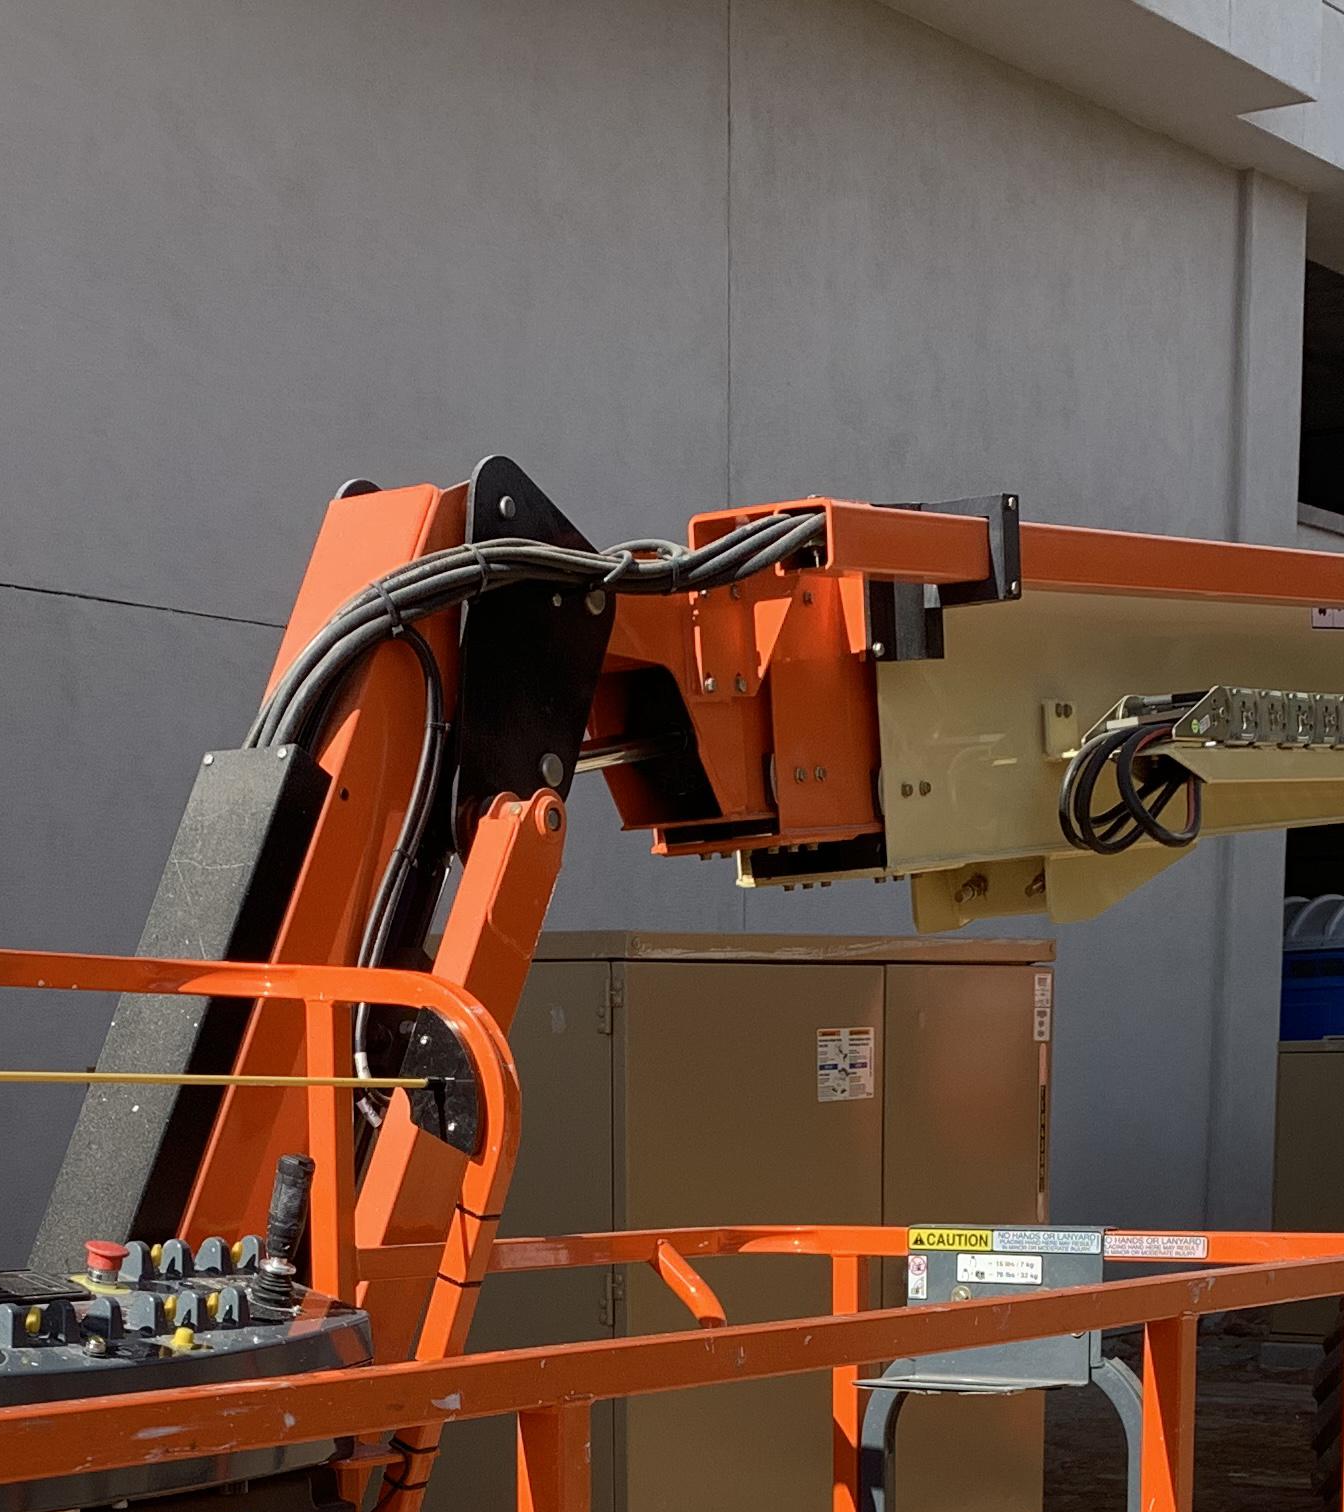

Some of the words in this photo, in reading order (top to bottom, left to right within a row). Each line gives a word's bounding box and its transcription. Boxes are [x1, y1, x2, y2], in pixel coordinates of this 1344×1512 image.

[926, 1232, 989, 1248] CAUTION
[1013, 1232, 1041, 1240] HANDS
[1057, 1233, 1096, 1242] LANYARD
